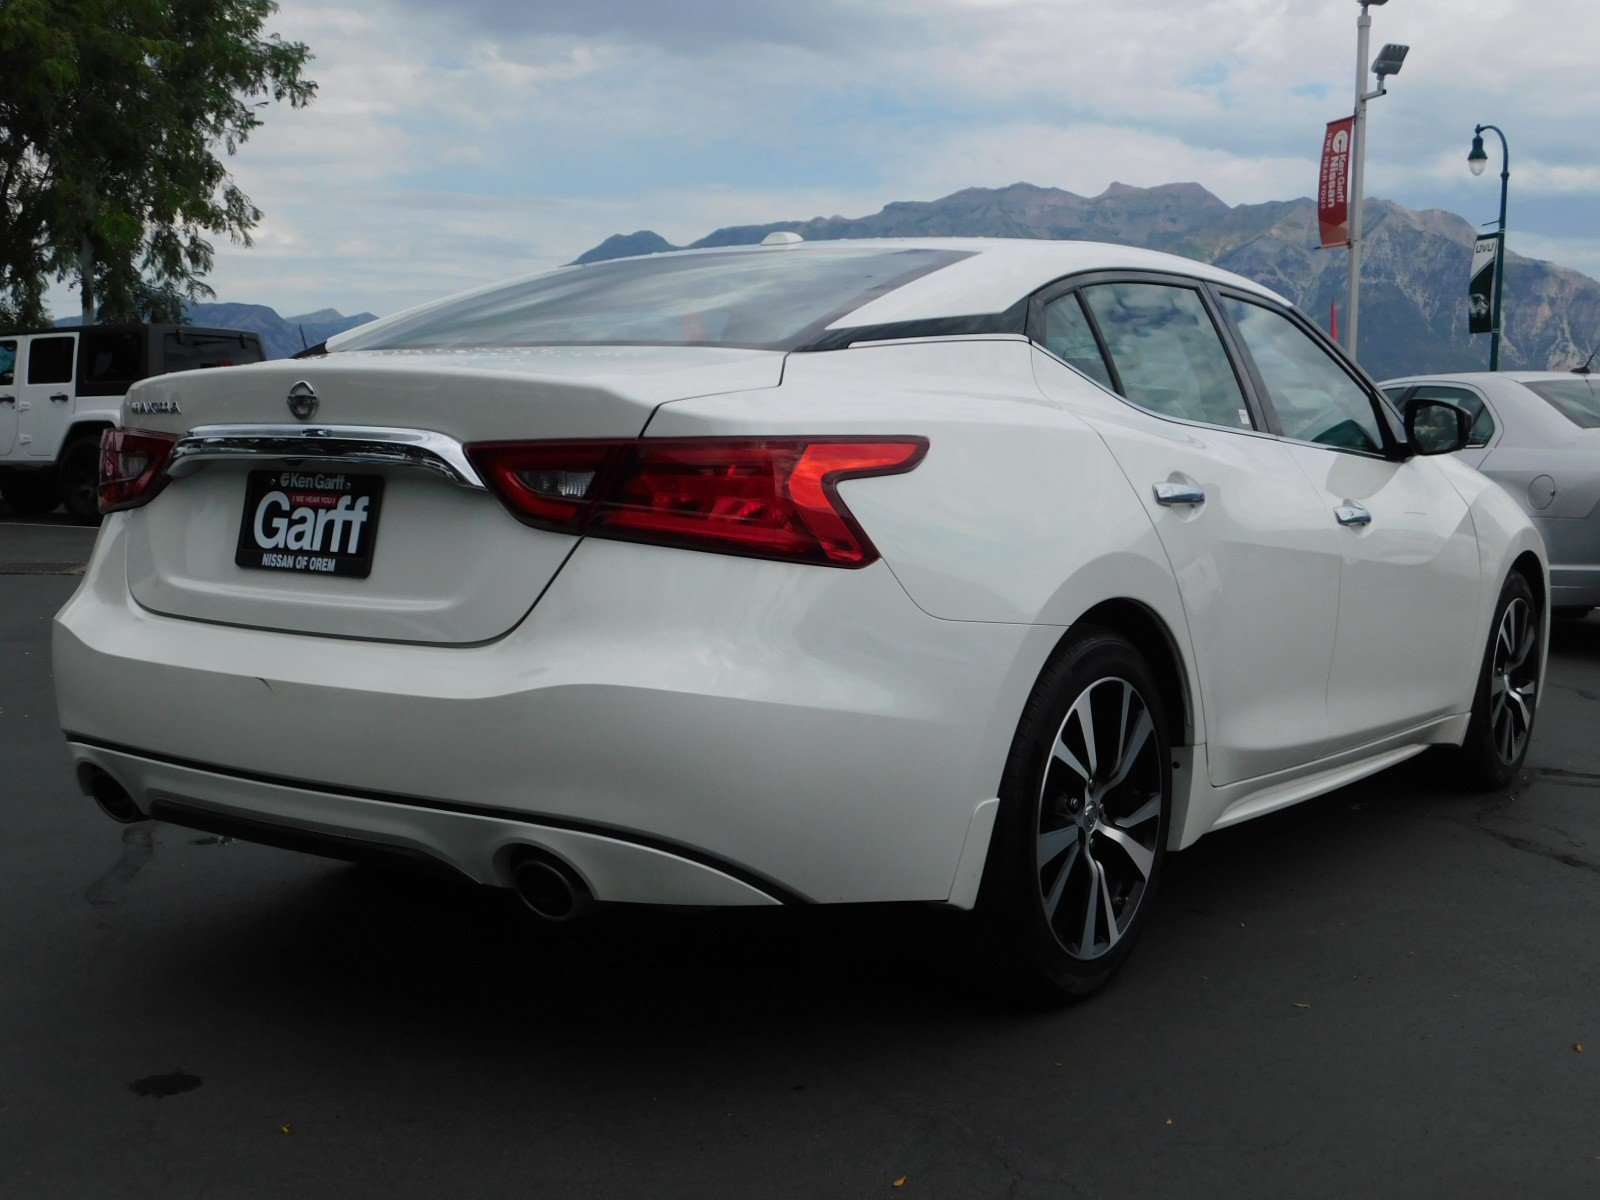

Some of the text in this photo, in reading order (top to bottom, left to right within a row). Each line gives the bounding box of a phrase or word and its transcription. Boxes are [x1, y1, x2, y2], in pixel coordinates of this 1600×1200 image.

[1327, 156, 1340, 208] Nissan
[1336, 154, 1347, 203] Ken Garff
[290, 473, 314, 488] Ken
[314, 474, 346, 490] Garff
[305, 496, 320, 504] HEAR
[253, 490, 370, 554] Garff
[262, 553, 336, 572] NISSAN OF OREM
